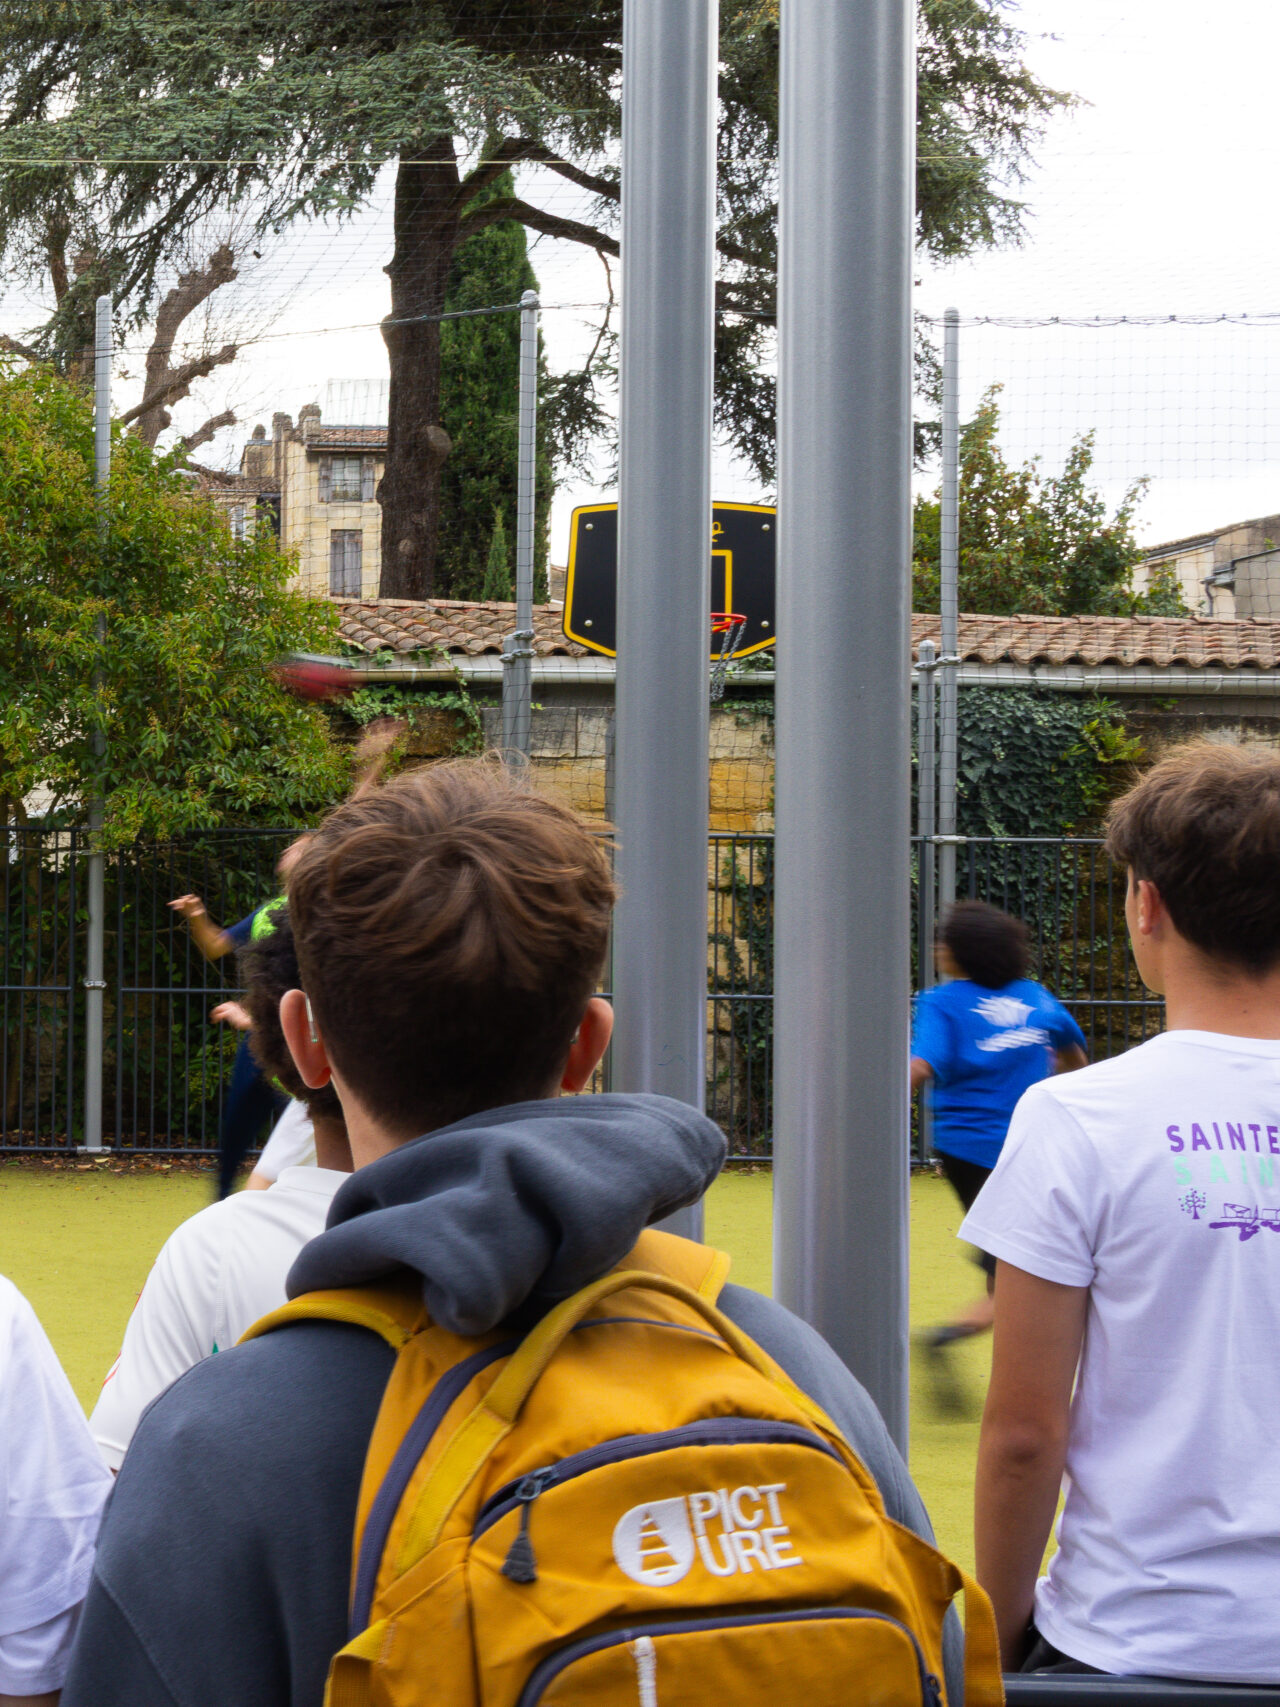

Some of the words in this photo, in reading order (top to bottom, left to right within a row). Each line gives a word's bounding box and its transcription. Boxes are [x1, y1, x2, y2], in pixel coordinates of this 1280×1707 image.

[1166, 1122, 1280, 1154] SAINTE
[689, 1483, 787, 1537] PICT
[696, 1526, 803, 1577] URE
